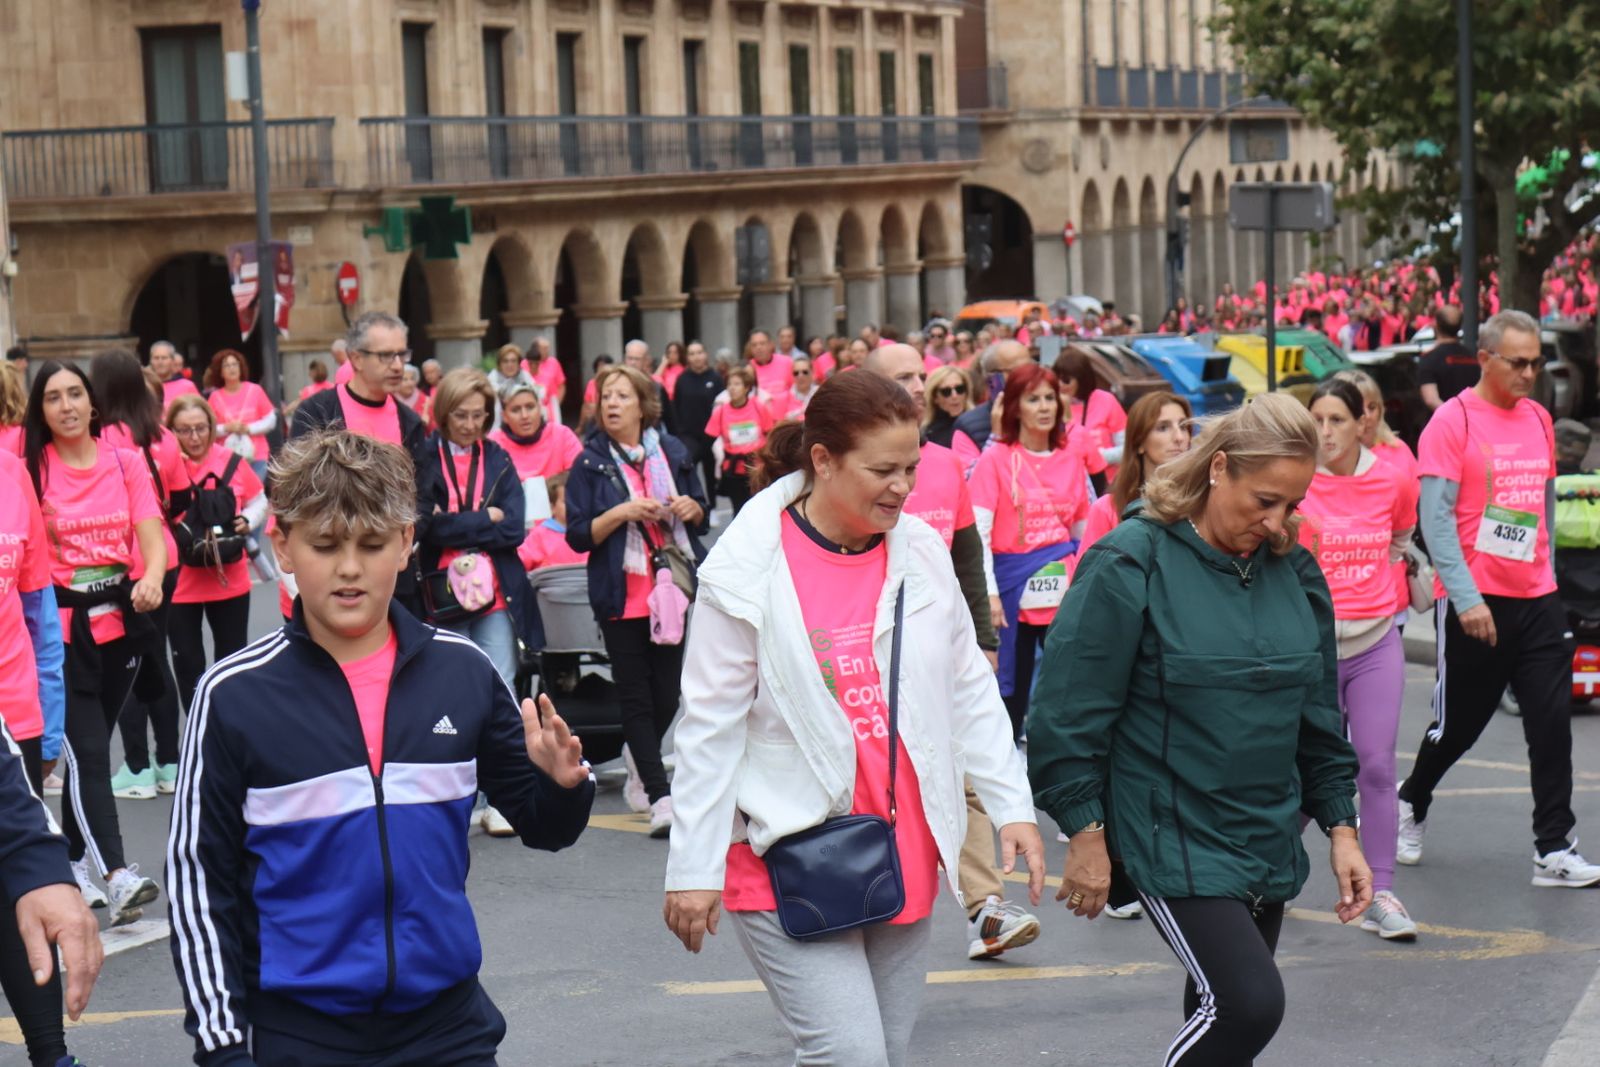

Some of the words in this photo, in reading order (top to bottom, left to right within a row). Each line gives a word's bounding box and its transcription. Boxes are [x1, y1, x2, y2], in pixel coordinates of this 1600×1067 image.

[1493, 458, 1511, 471] En
[913, 506, 953, 521] archa
[56, 518, 77, 531] En
[1322, 531, 1342, 545] En
[1493, 524, 1527, 542] 4352
[1029, 577, 1059, 593] 4252
[836, 654, 865, 676] En
[852, 706, 888, 741] cá
